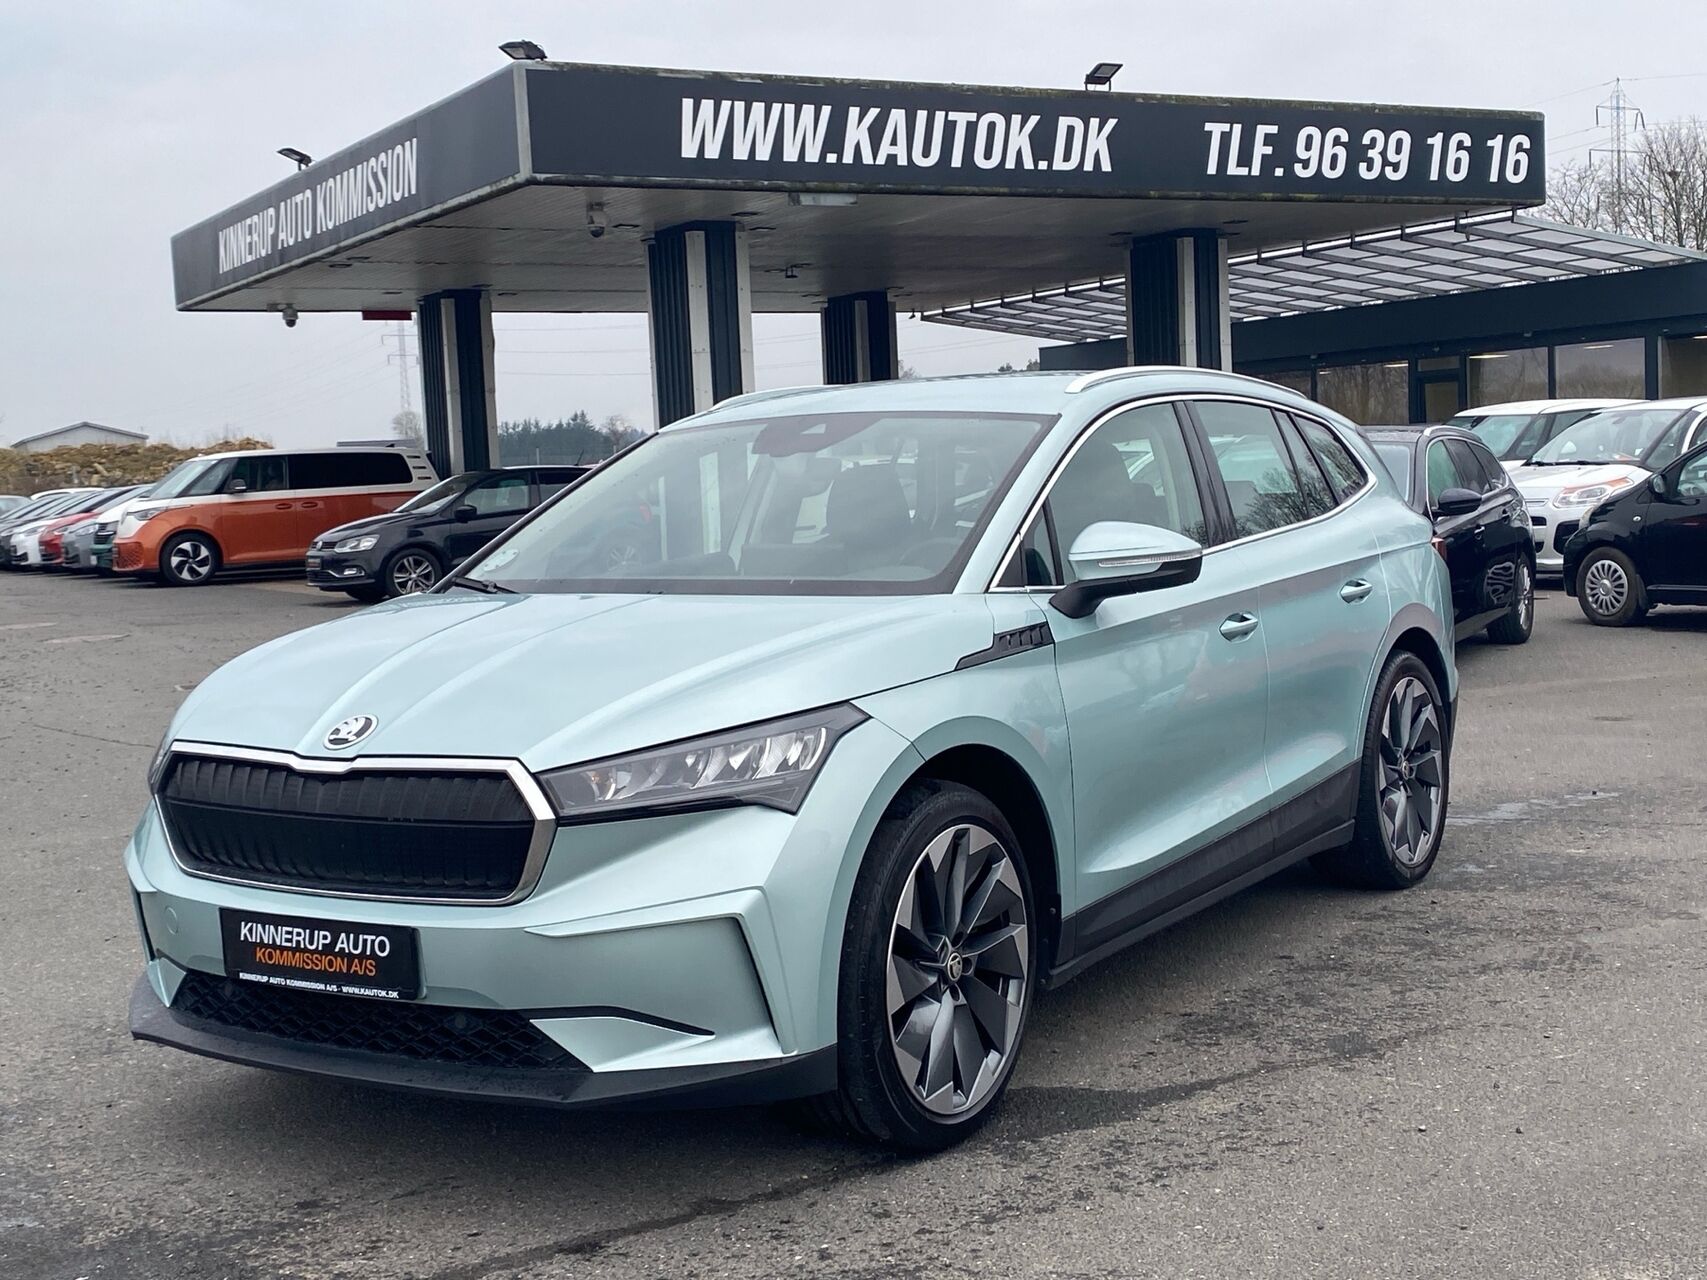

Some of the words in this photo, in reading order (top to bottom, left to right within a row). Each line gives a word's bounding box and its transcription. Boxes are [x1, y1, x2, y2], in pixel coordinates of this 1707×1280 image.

[681, 97, 1119, 172] WWW.KAUTOK.DK
[1203, 122, 1285, 177] TLF.
[1293, 126, 1349, 180] 96
[1358, 128, 1412, 181] 39
[1426, 131, 1472, 182] 16
[1486, 133, 1531, 184] 16
[218, 206, 276, 274] KINNERUP
[277, 188, 313, 250] AUTO
[316, 137, 418, 235] KOMMISSION
[240, 921, 331, 951] KINNERUP
[335, 933, 391, 957] AUTO
[256, 947, 348, 973] KOMMISSION
[351, 959, 376, 977] A/S
[269, 976, 286, 986] AUTO
